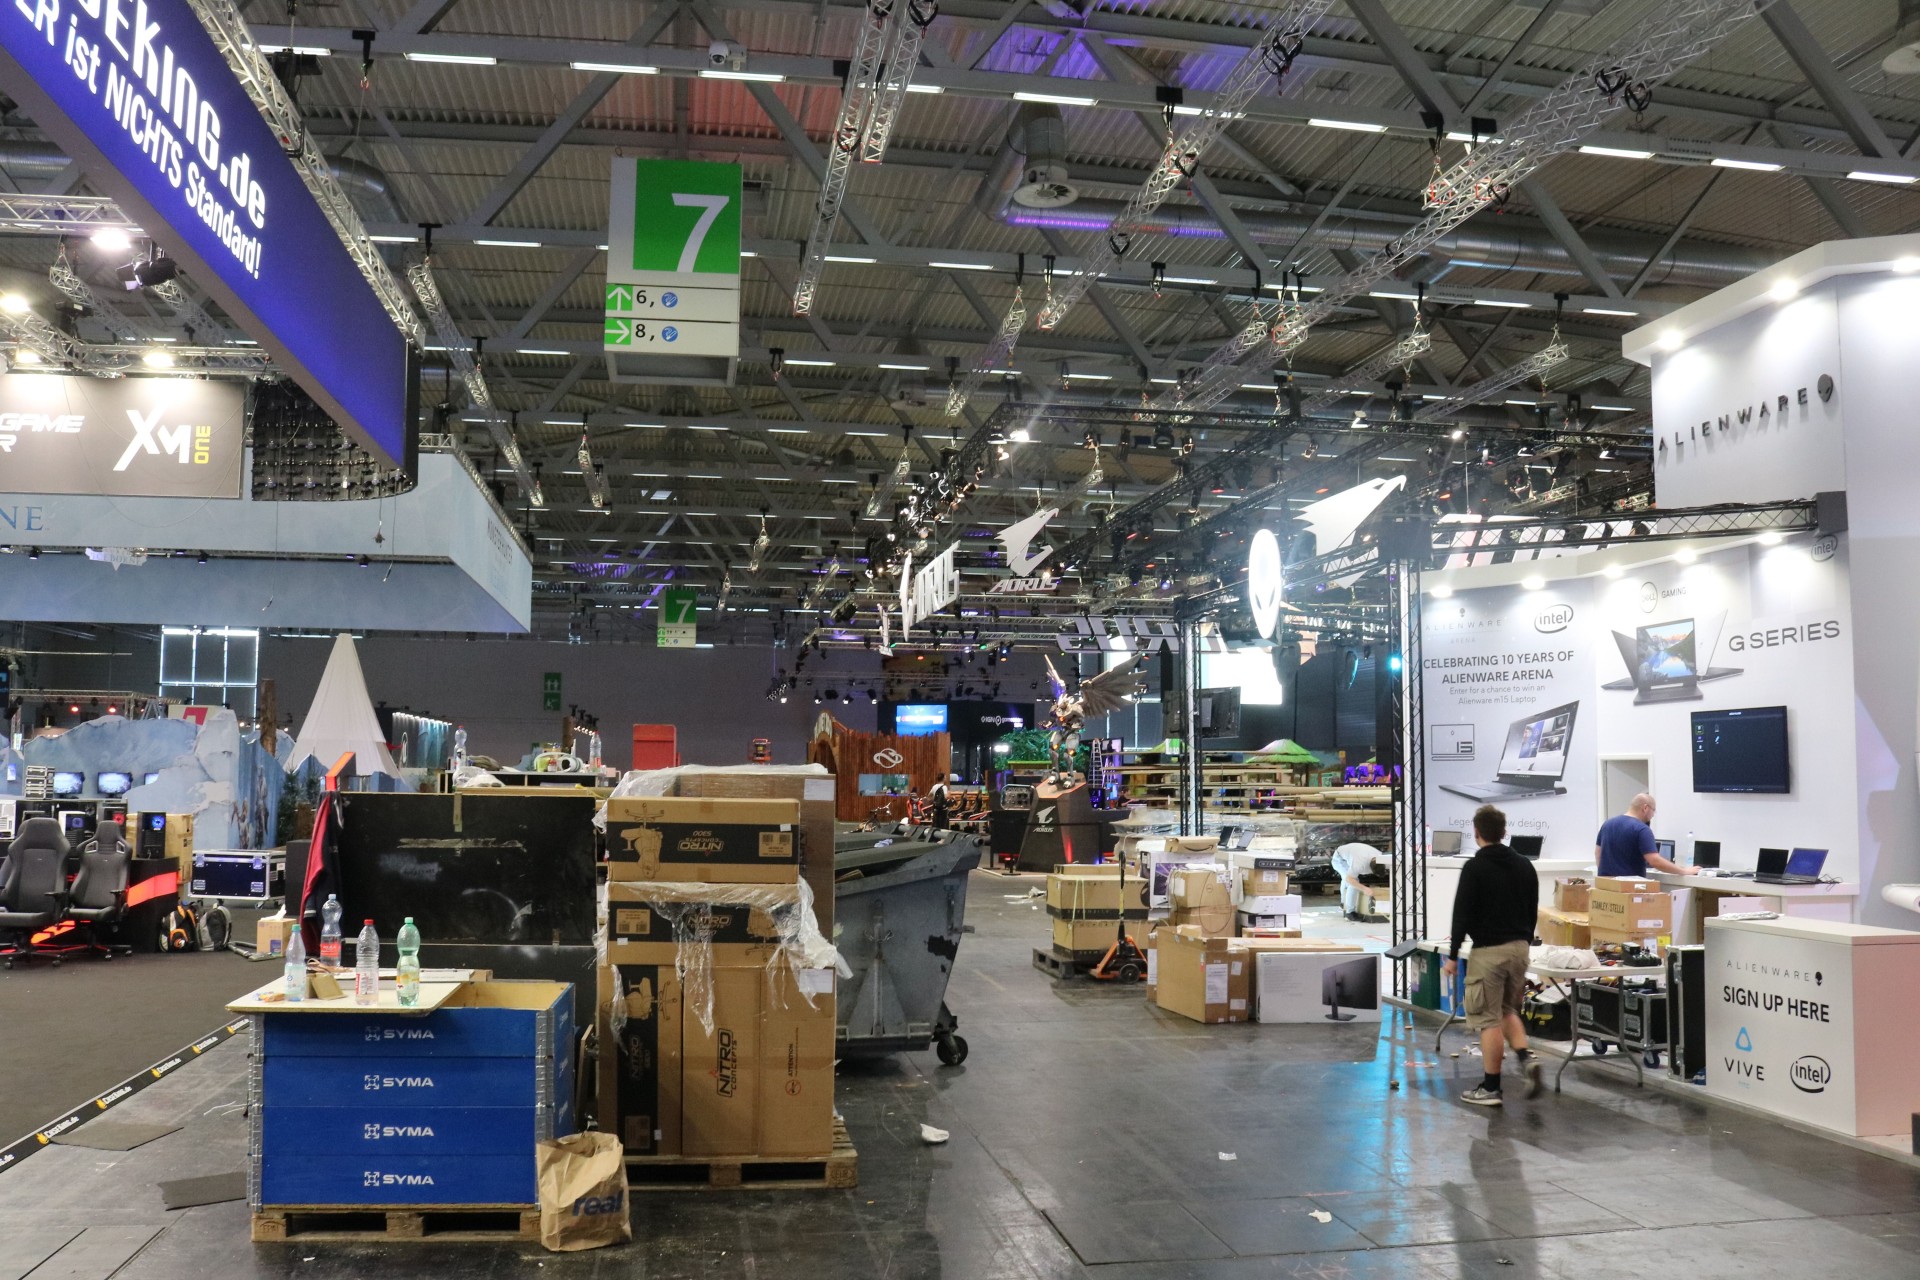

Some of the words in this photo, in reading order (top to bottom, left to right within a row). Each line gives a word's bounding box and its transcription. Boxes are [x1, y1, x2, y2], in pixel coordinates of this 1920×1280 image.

[64, 13, 101, 94] ist
[104, 62, 184, 189] NICHTS
[185, 161, 262, 280] Standard!
[672, 193, 730, 273] 7
[1658, 387, 1809, 451] ALIENWARE
[1814, 540, 1835, 556] intel
[988, 577, 1062, 593] AORUS
[1661, 587, 1686, 598] GAMING
[676, 599, 693, 625] 7
[1539, 610, 1568, 625] intel
[1425, 619, 1502, 631] ALIENWARE
[1423, 655, 1499, 669] CELEBRATING
[1502, 654, 1514, 665] 10
[1516, 651, 1555, 664] YEARS
[1557, 650, 1574, 662] OF
[1442, 670, 1509, 684] ALIENWARE
[1512, 668, 1554, 681] ARENA
[1449, 686, 1468, 695] Enter
[1469, 685, 1480, 694] for
[1486, 685, 1511, 693] chance
[1522, 683, 1535, 692] win
[1458, 697, 1493, 705] Alienware
[1494, 695, 1509, 703] m15
[1510, 695, 1537, 704] Laptop
[680, 841, 722, 850] NITRO
[1726, 960, 1810, 982] ALIENWARE
[1723, 985, 1759, 1008] SIGN
[1763, 994, 1784, 1013] UP
[1788, 998, 1830, 1023] HERE
[383, 1029, 435, 1039] SYMA
[719, 1031, 732, 1095] NITRO
[1724, 1057, 1766, 1081] VIVE
[1795, 1062, 1825, 1084] intel
[382, 1077, 435, 1088] SYMA
[382, 1126, 435, 1137] SYMA
[382, 1174, 435, 1185] SYMA
[571, 1191, 625, 1217] real
